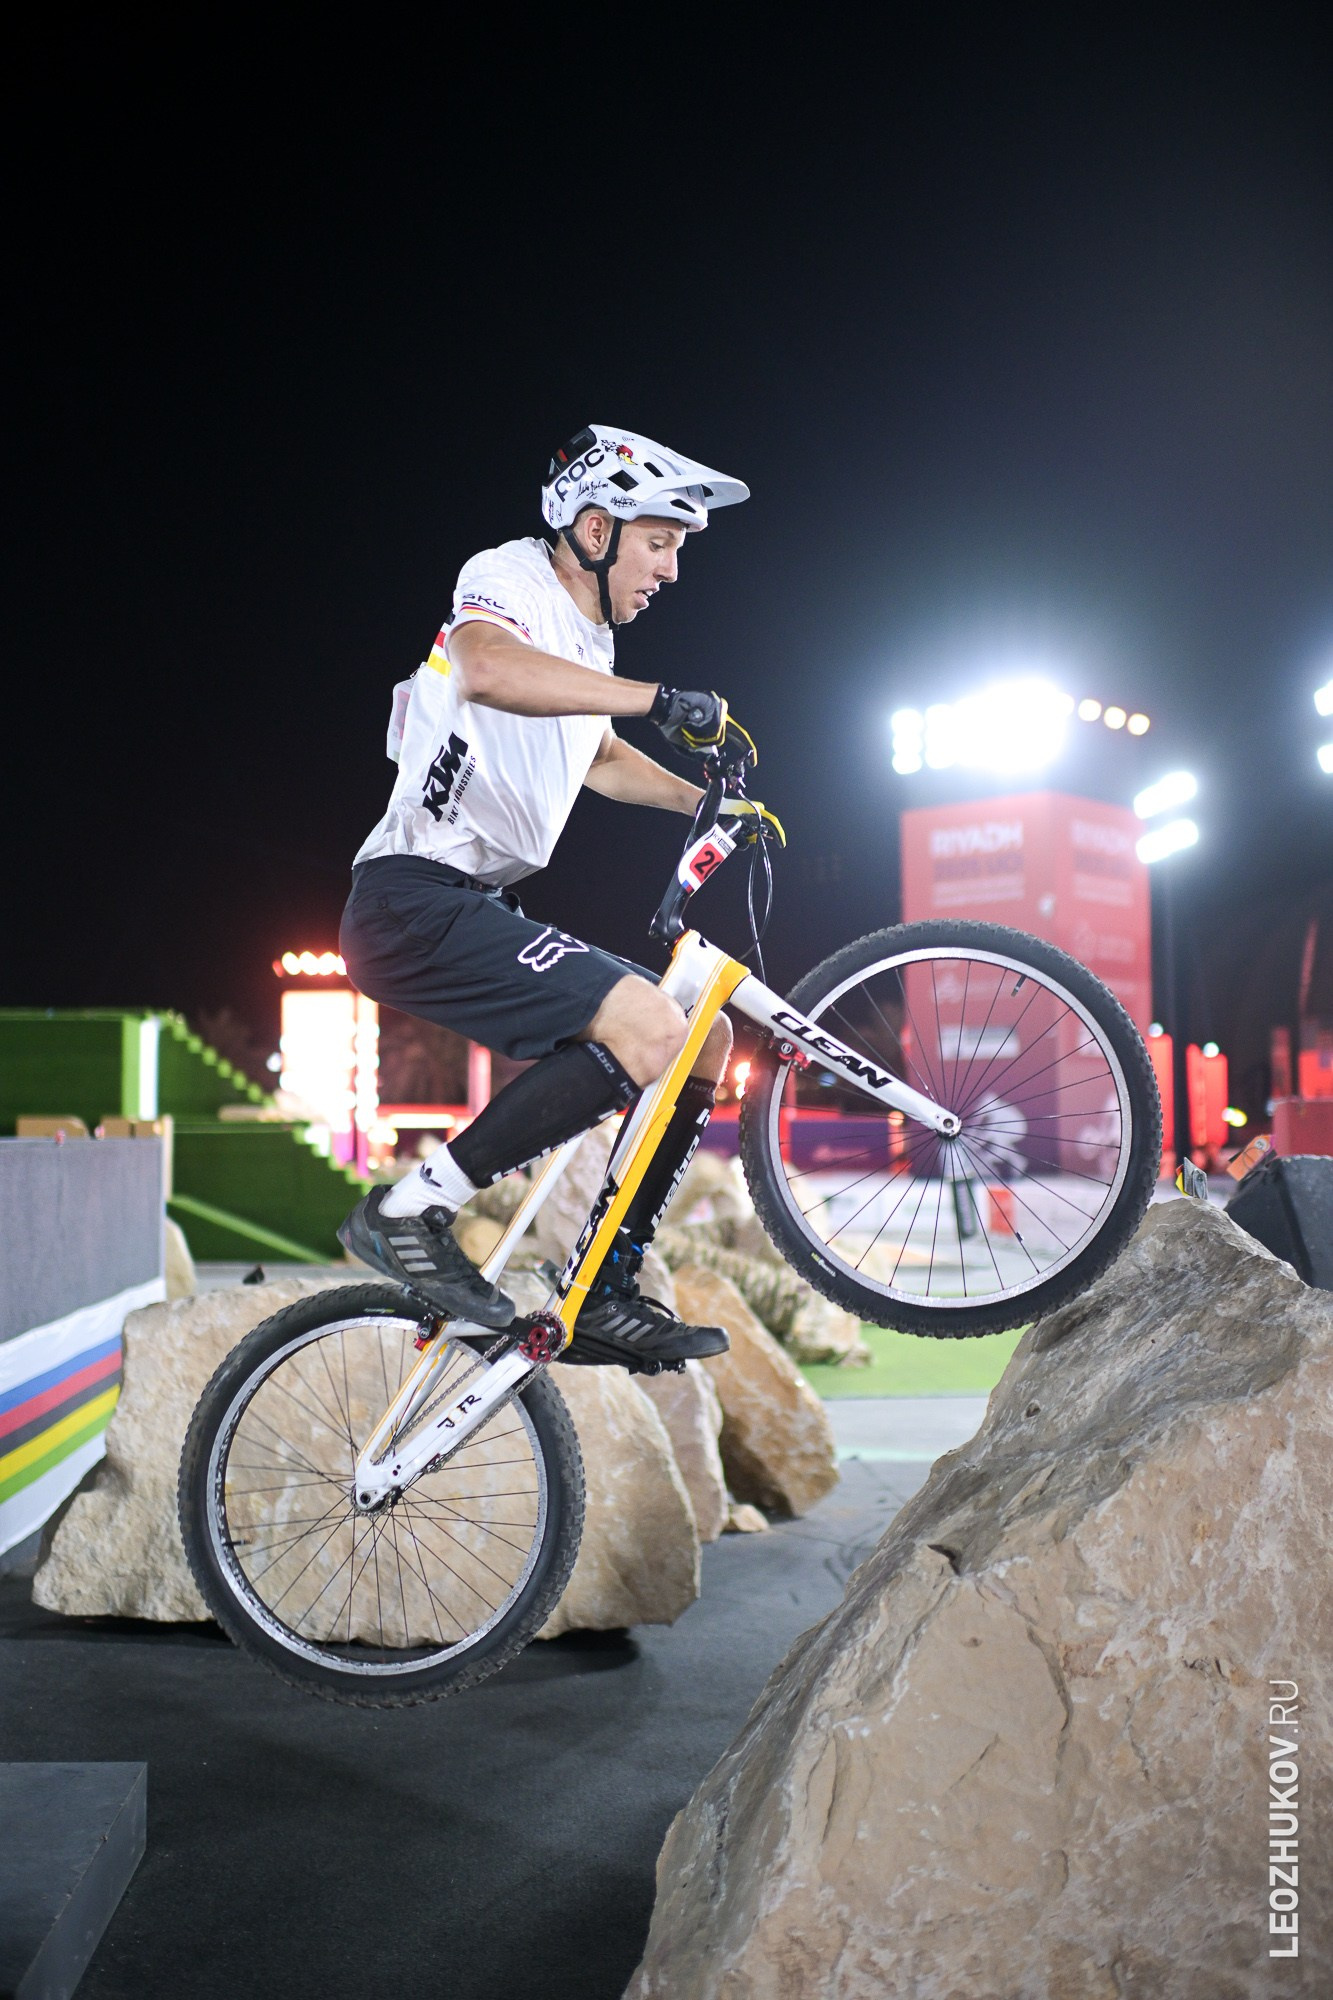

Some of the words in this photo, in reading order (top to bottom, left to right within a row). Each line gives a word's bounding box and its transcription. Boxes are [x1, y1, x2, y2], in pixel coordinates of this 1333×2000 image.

[422, 731, 469, 822] KTM
[694, 850, 721, 879] 2
[771, 1011, 892, 1089] CLEAN
